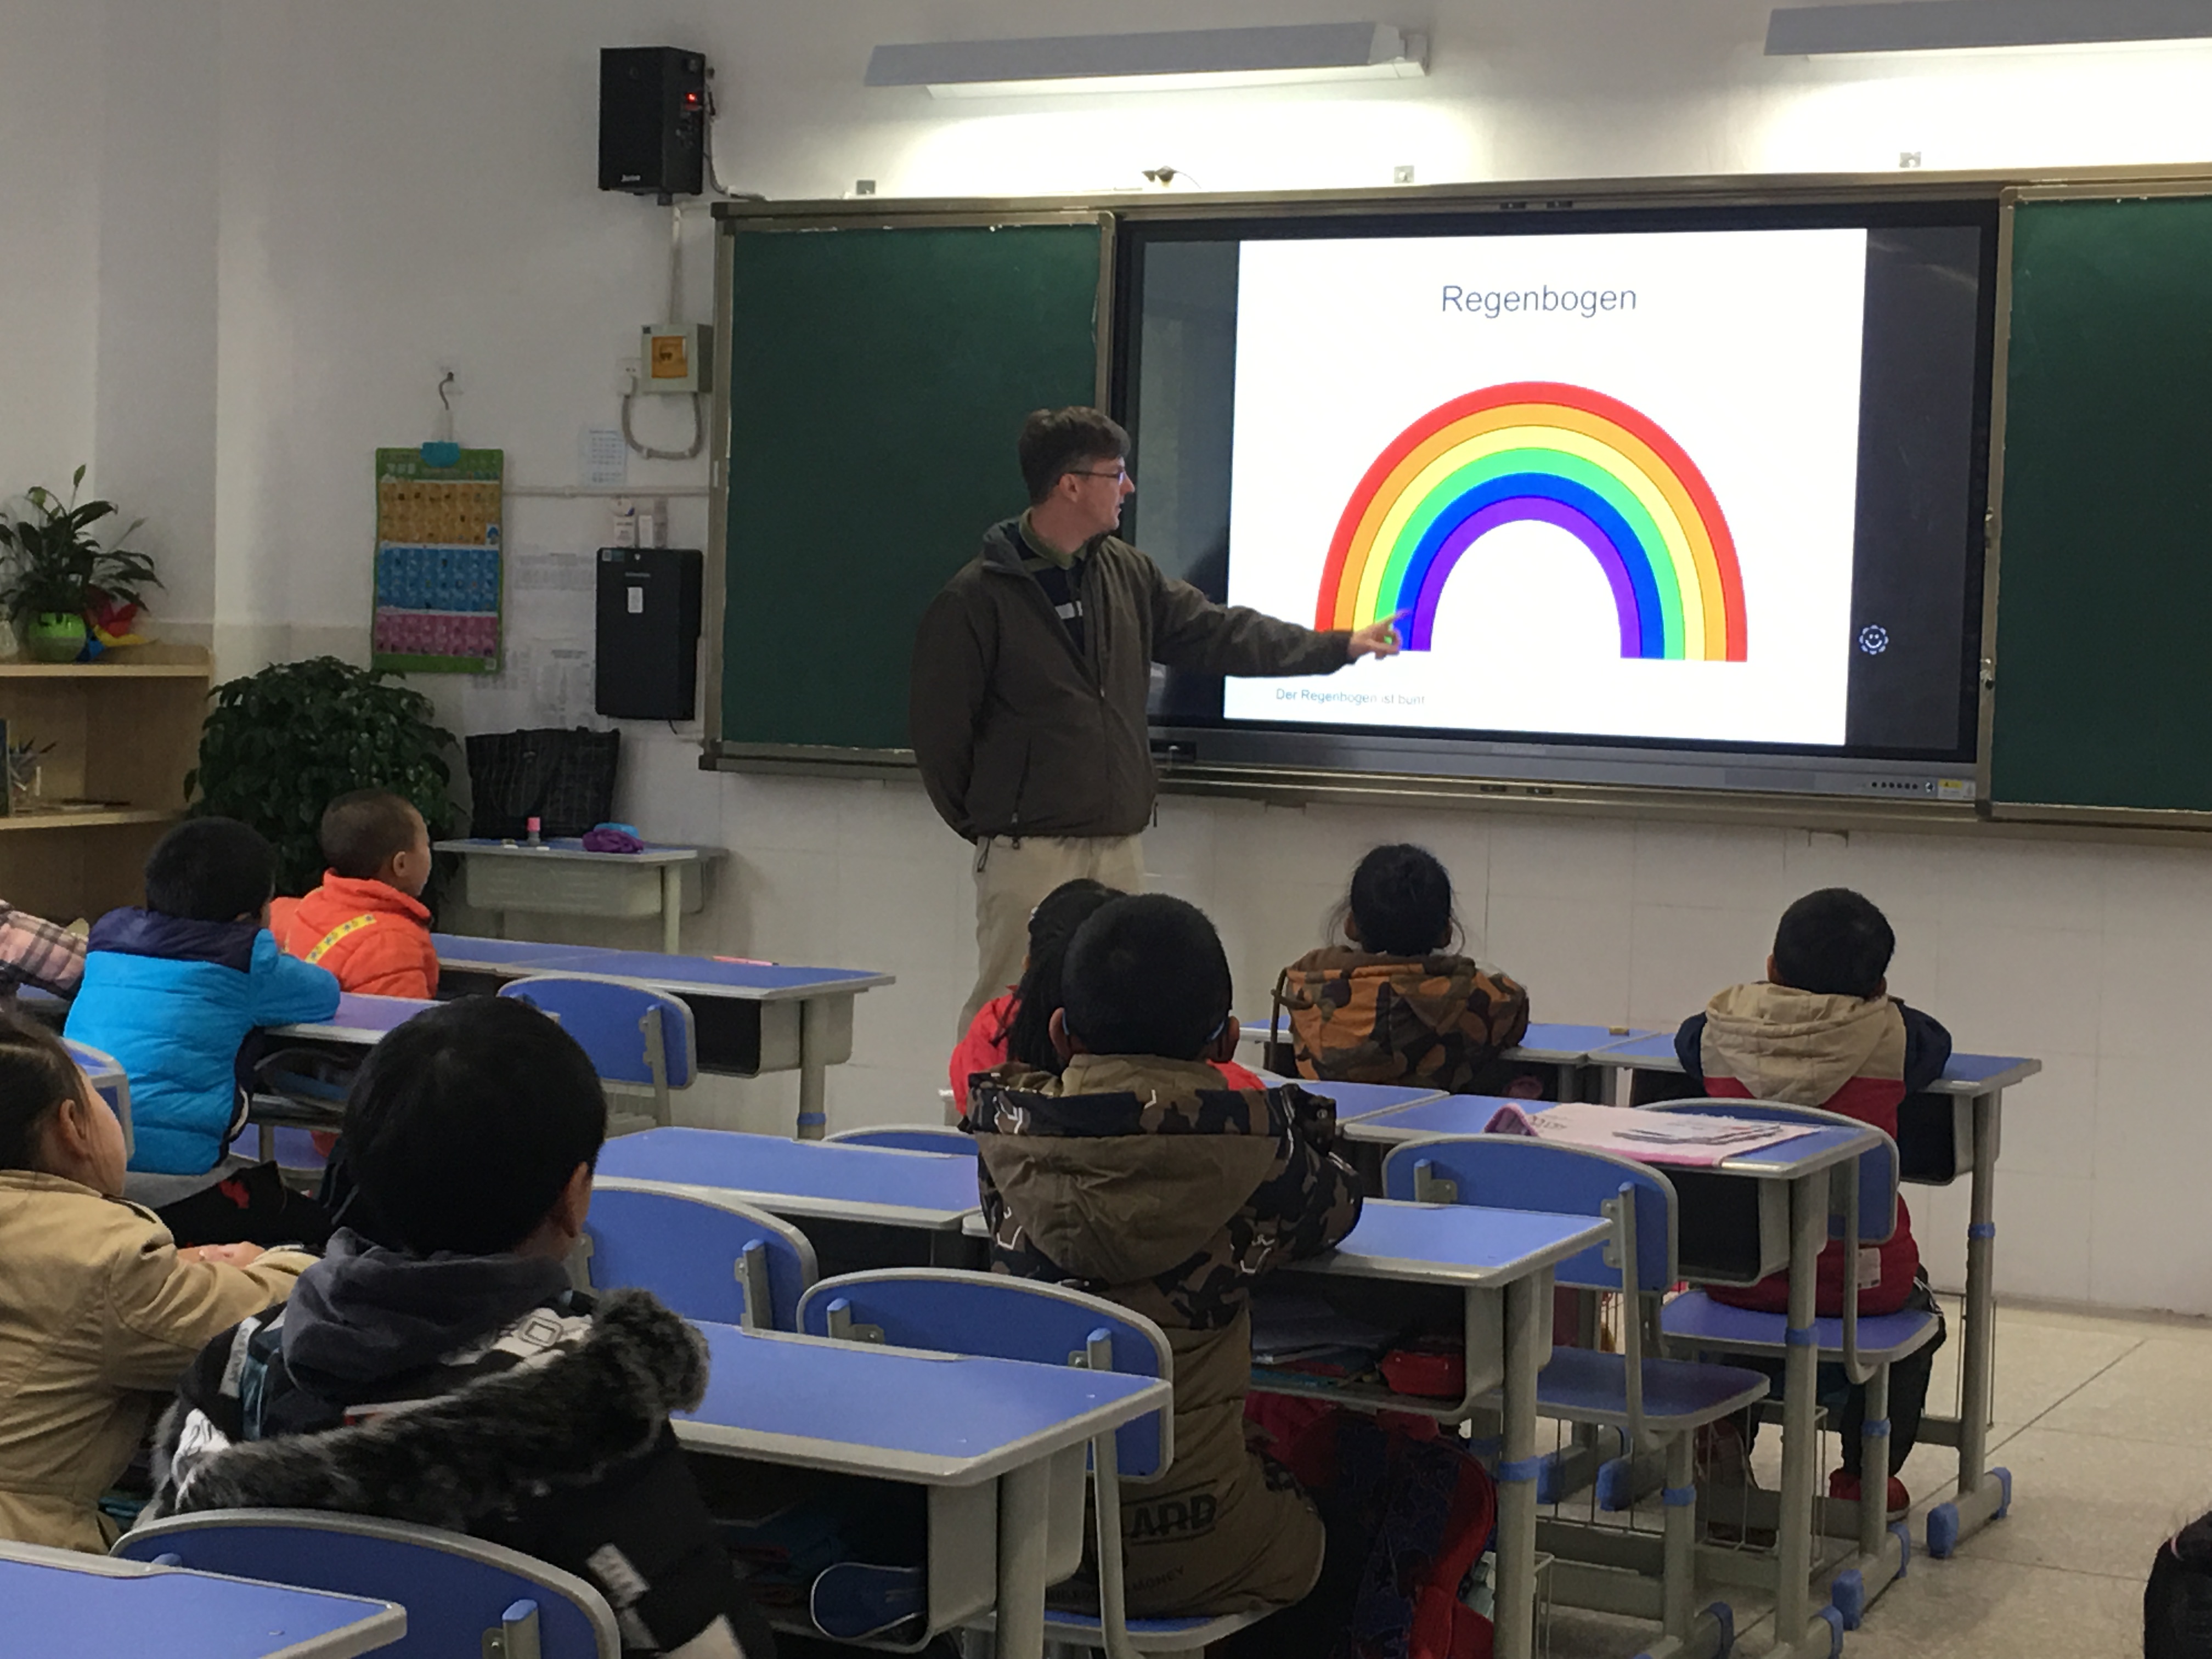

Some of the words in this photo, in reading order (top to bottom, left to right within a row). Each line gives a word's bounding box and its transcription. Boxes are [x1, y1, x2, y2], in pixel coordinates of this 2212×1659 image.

[1442, 285, 1636, 319] Regenbogen
[1276, 688, 1297, 700] Der
[1301, 689, 1377, 706] Regenbogen
[1398, 694, 1425, 705] bunt
